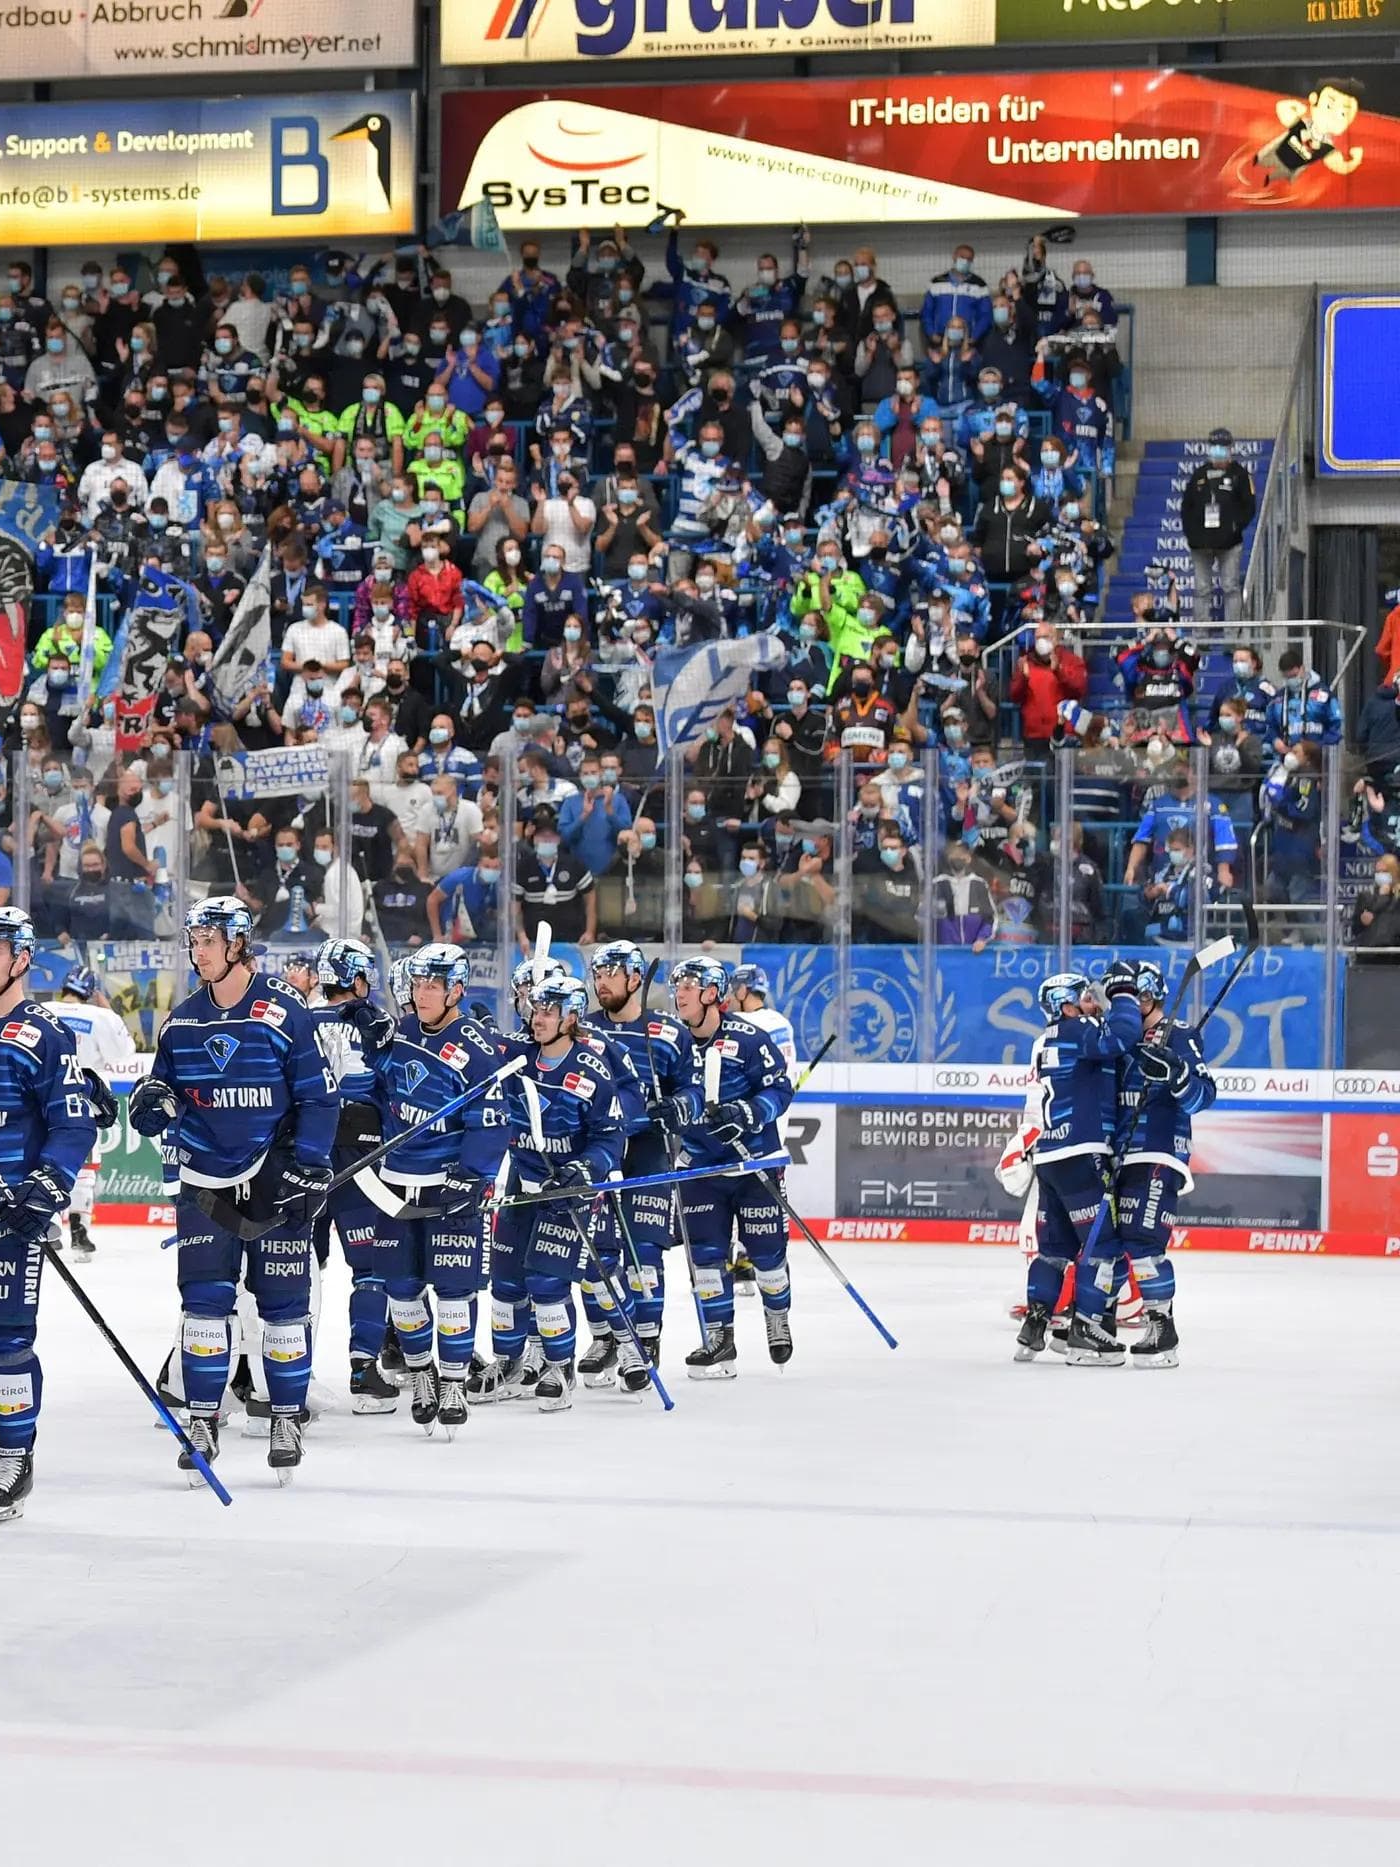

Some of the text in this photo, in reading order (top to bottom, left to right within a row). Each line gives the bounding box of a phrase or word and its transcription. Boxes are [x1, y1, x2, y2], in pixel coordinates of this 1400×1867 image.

[92, 2, 203, 25] Abbruch
[113, 34, 382, 61] www.schmidmeyer.net
[643, 34, 933, 53] Siemensstr. 7 Gaimersheim
[850, 93, 1046, 127] IT-Helden für
[5, 133, 88, 159] Support
[93, 132, 111, 153] &
[117, 129, 254, 155] Development
[987, 132, 1200, 165] Unternehmen
[481, 179, 650, 213] SysTec
[104, 1062, 144, 1074] Audi
[1264, 1076, 1310, 1092] Audi
[212, 1087, 273, 1109] SATURN
[861, 1111, 1011, 1130] BRING DEN PUCK
[861, 1130, 930, 1148] BEWIRB
[935, 1131, 980, 1149] DICH
[631, 1194, 669, 1211] HERRN
[432, 1234, 476, 1249] HERRN
[538, 1221, 580, 1243] HERRN
[261, 1239, 308, 1255] HERRN
[480, 1213, 492, 1275] SATURN
